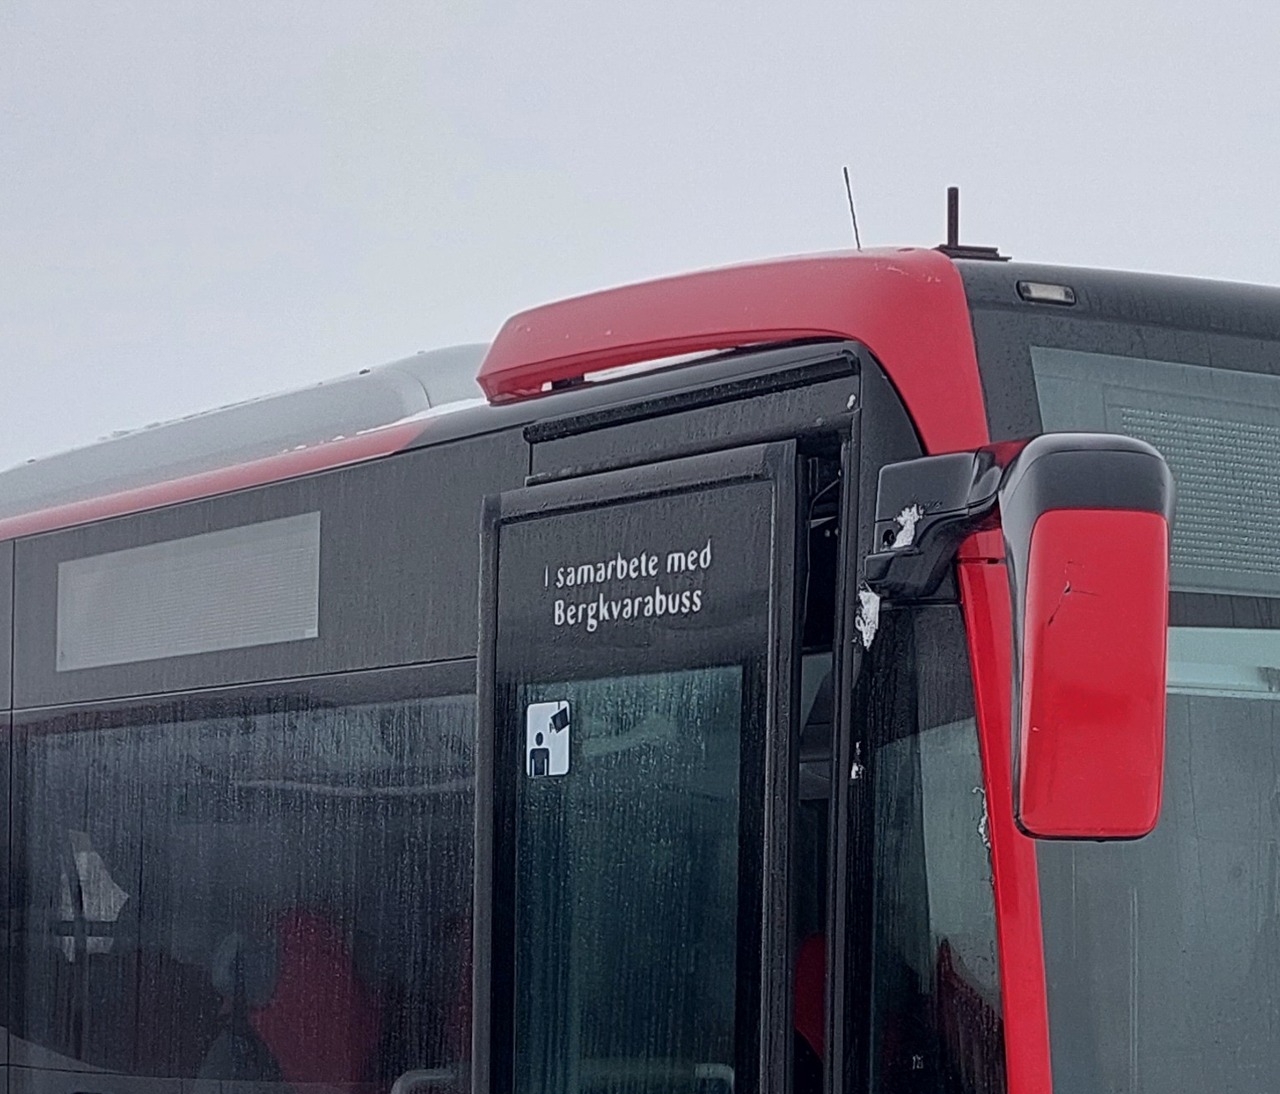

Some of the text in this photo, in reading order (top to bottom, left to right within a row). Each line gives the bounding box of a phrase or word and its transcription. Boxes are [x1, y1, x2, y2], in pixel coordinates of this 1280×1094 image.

[544, 538, 713, 589] I samarbete med
[554, 585, 703, 633] Bergkvarabuss
